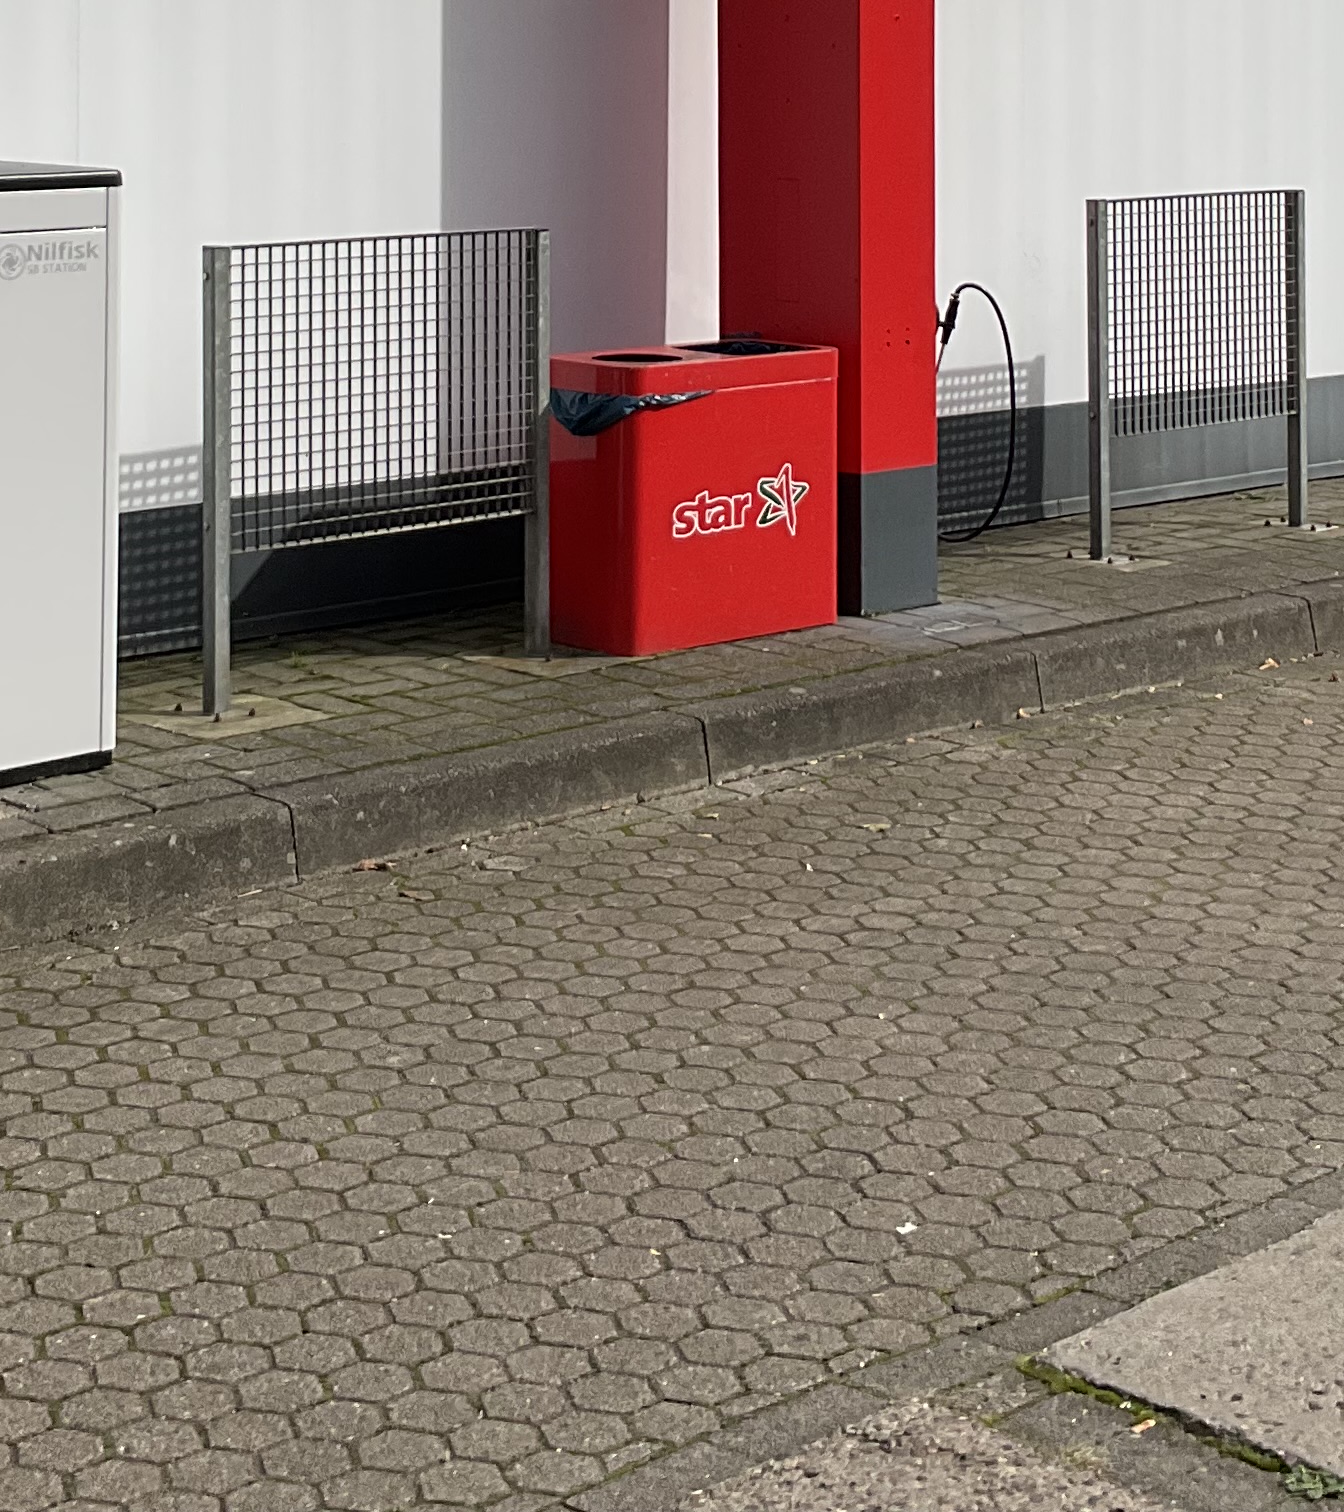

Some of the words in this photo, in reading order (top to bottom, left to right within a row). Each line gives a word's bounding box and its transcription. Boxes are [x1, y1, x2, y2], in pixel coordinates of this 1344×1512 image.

[27, 241, 99, 262] Nilfisk
[43, 262, 87, 274] STATION
[672, 491, 752, 539] star
